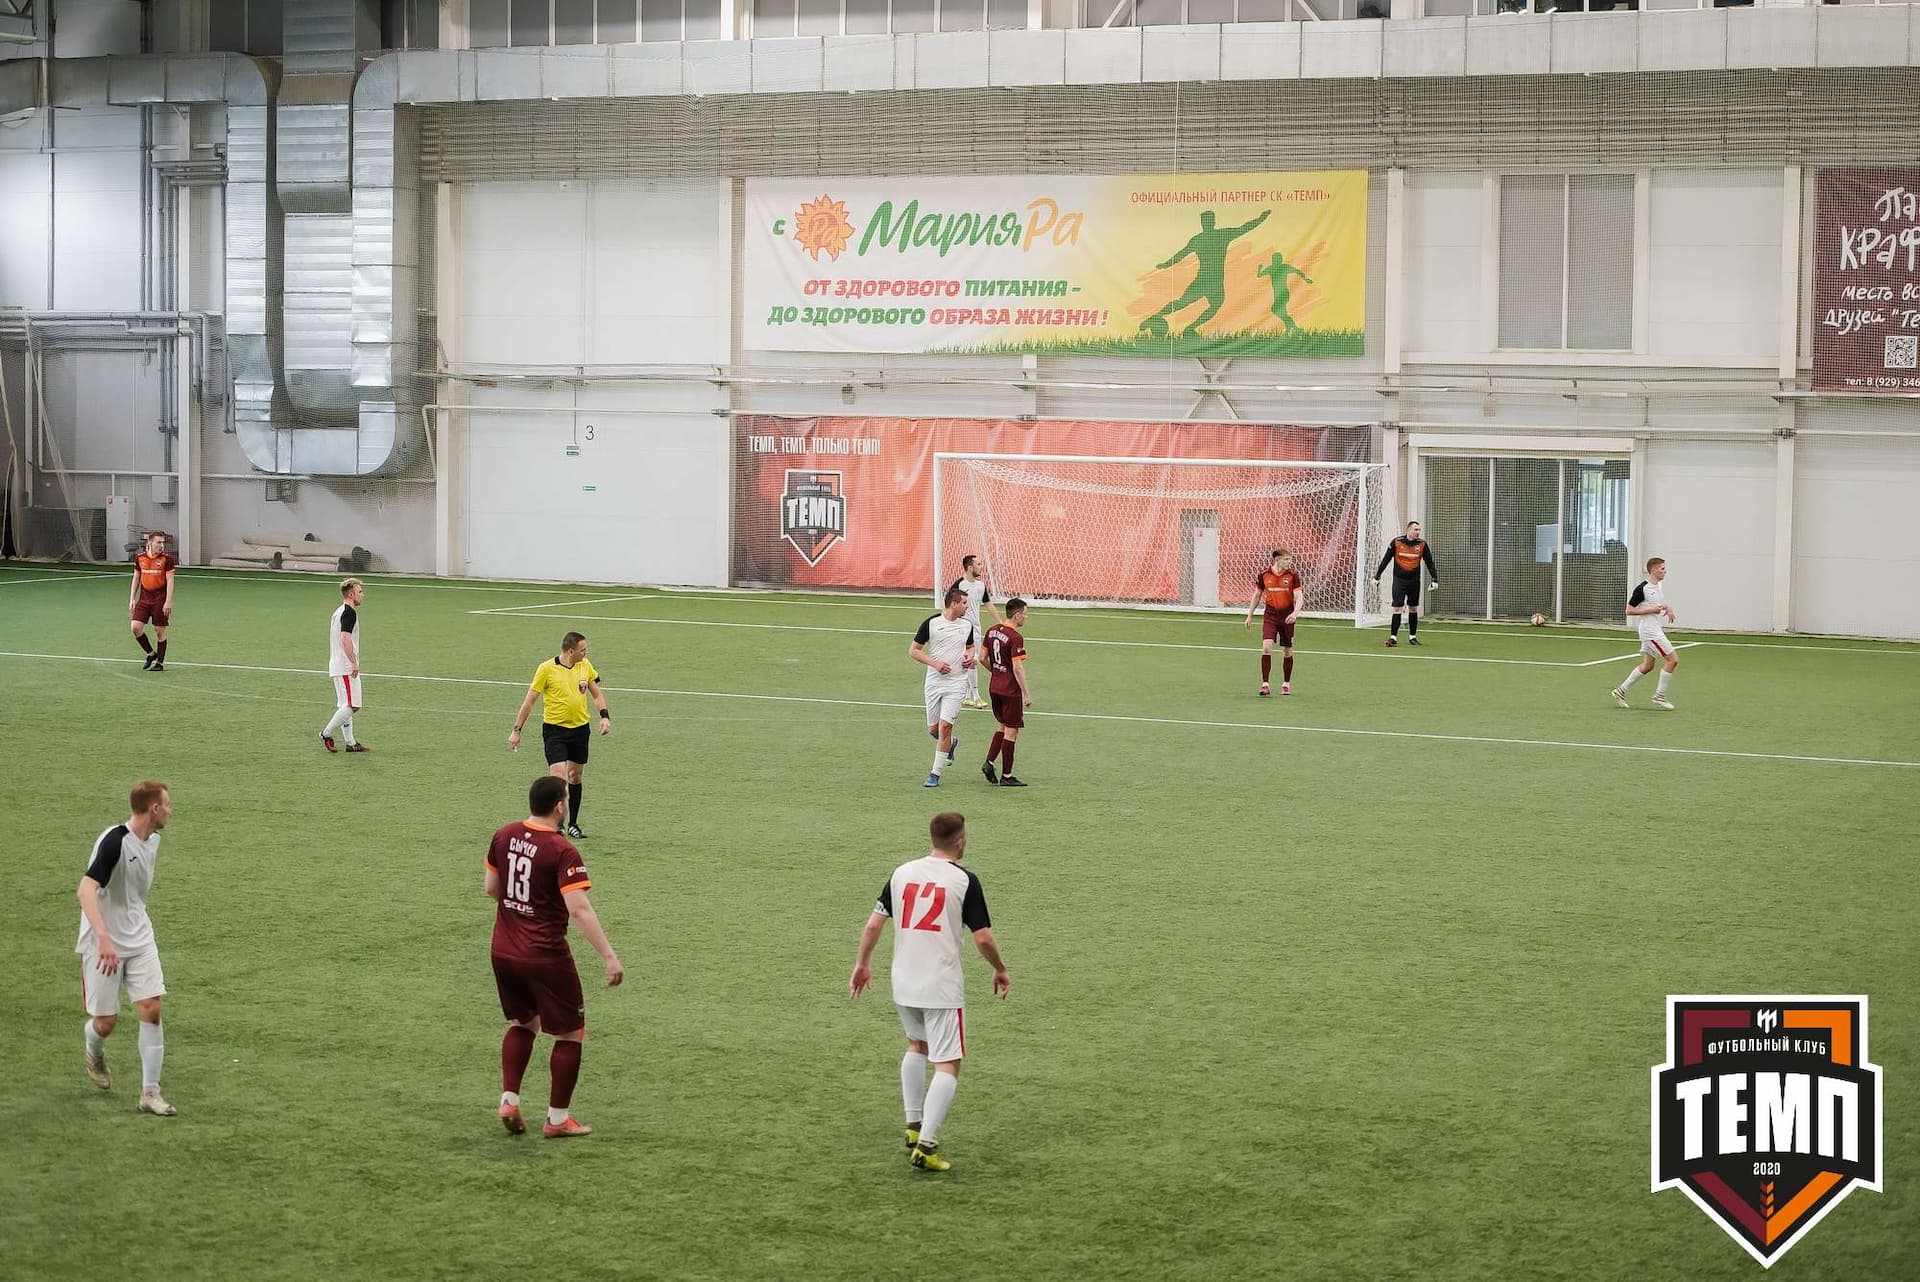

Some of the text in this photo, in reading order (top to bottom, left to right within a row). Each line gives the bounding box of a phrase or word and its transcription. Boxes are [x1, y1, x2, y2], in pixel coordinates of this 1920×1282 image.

[1131, 189, 1218, 205] ОФИЦИАЛЬНЫЙ
[1221, 191, 1267, 204] ПАРТНЕР
[1270, 190, 1284, 202] СК
[1874, 187, 1920, 222] Па
[803, 279, 832, 297] ОТ
[834, 279, 961, 299] ЗДОРОВОГО
[964, 279, 1069, 297] ПИТАНИЯ
[767, 306, 799, 326] ДО
[801, 306, 926, 327] ЗДОРОВОГО
[929, 308, 1012, 325] ОБРАЗА
[585, 424, 595, 441] 3
[749, 436, 778, 455] ТЕМП,
[811, 437, 849, 455] ТОЛЬКО
[787, 496, 840, 531] ТЕМП
[507, 852, 532, 902] 13
[901, 882, 946, 932] 12
